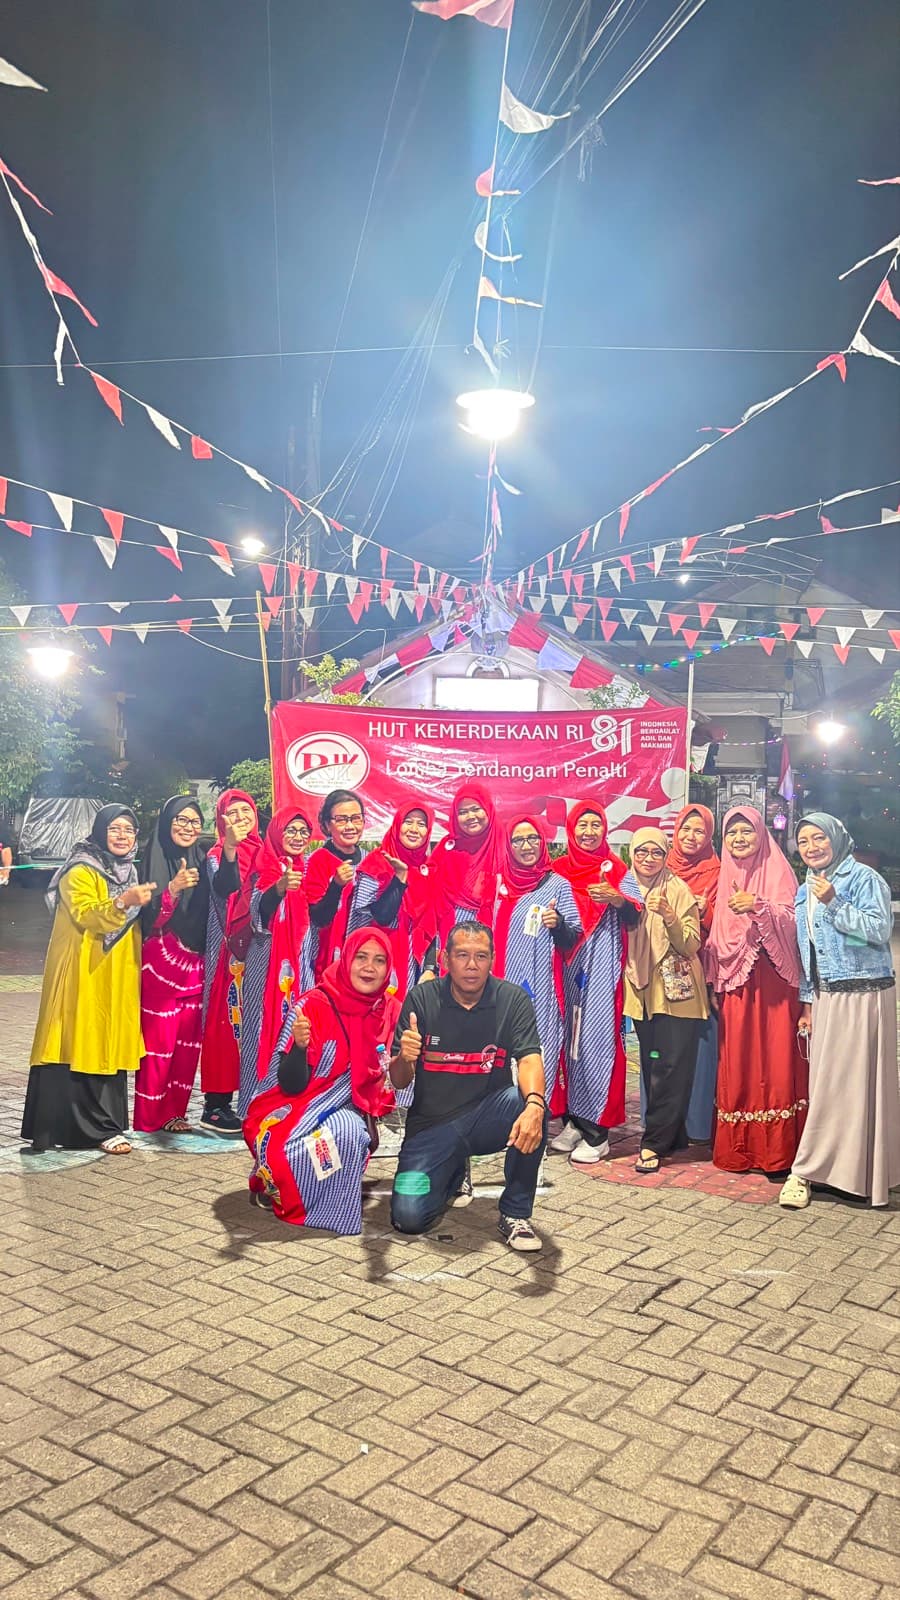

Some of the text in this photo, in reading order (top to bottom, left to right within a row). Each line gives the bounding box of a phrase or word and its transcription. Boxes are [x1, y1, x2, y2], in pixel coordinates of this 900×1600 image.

[368, 721, 584, 740] HUT KEMERDEKAAN RI
[591, 715, 635, 756] 81
[563, 761, 627, 778] Penalti
